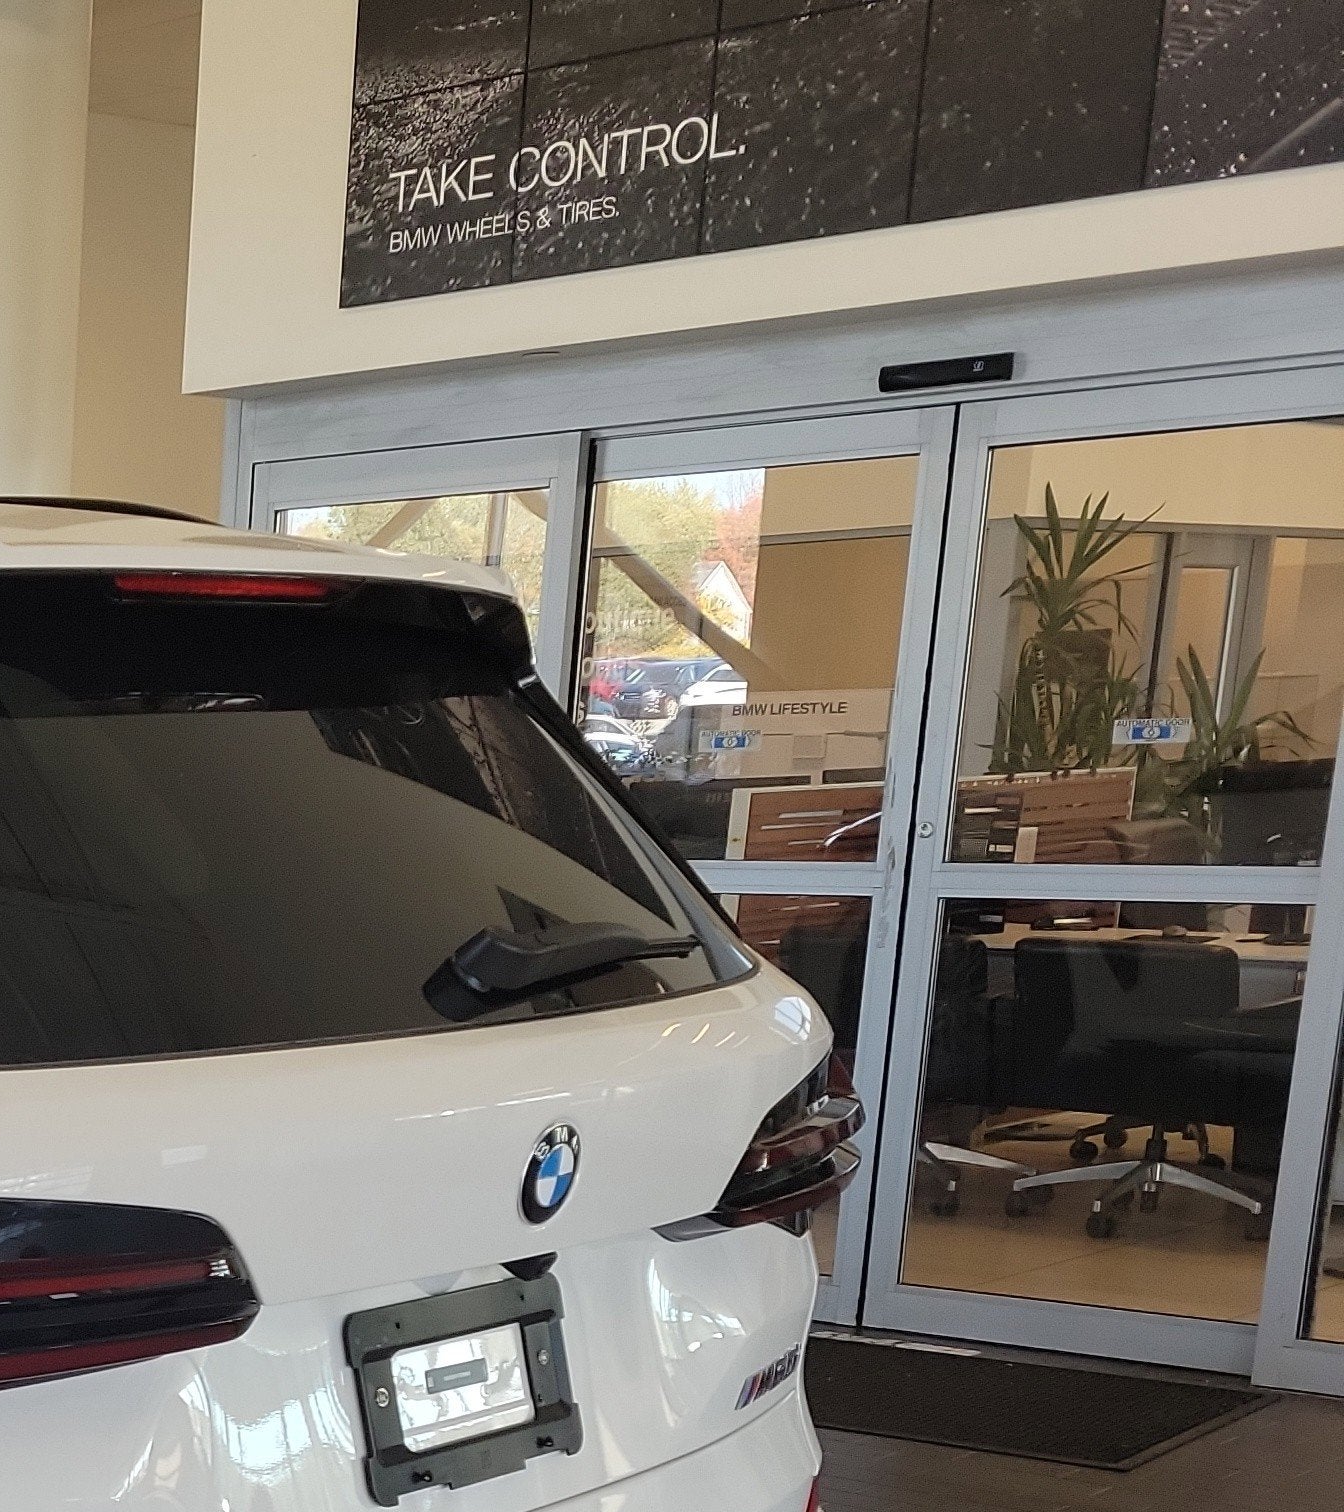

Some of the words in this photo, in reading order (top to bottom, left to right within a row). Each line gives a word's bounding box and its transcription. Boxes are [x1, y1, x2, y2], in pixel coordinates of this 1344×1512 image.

[389, 154, 496, 213] TAKE
[509, 112, 746, 194] CONTROL.
[389, 223, 442, 253] BMW
[447, 211, 532, 243] WHEELS
[537, 206, 552, 229] &
[559, 196, 621, 223] TIRES.
[732, 703, 767, 717] BMW
[770, 701, 848, 716] LIFESTYLE
[533, 1126, 579, 1160] BMW
